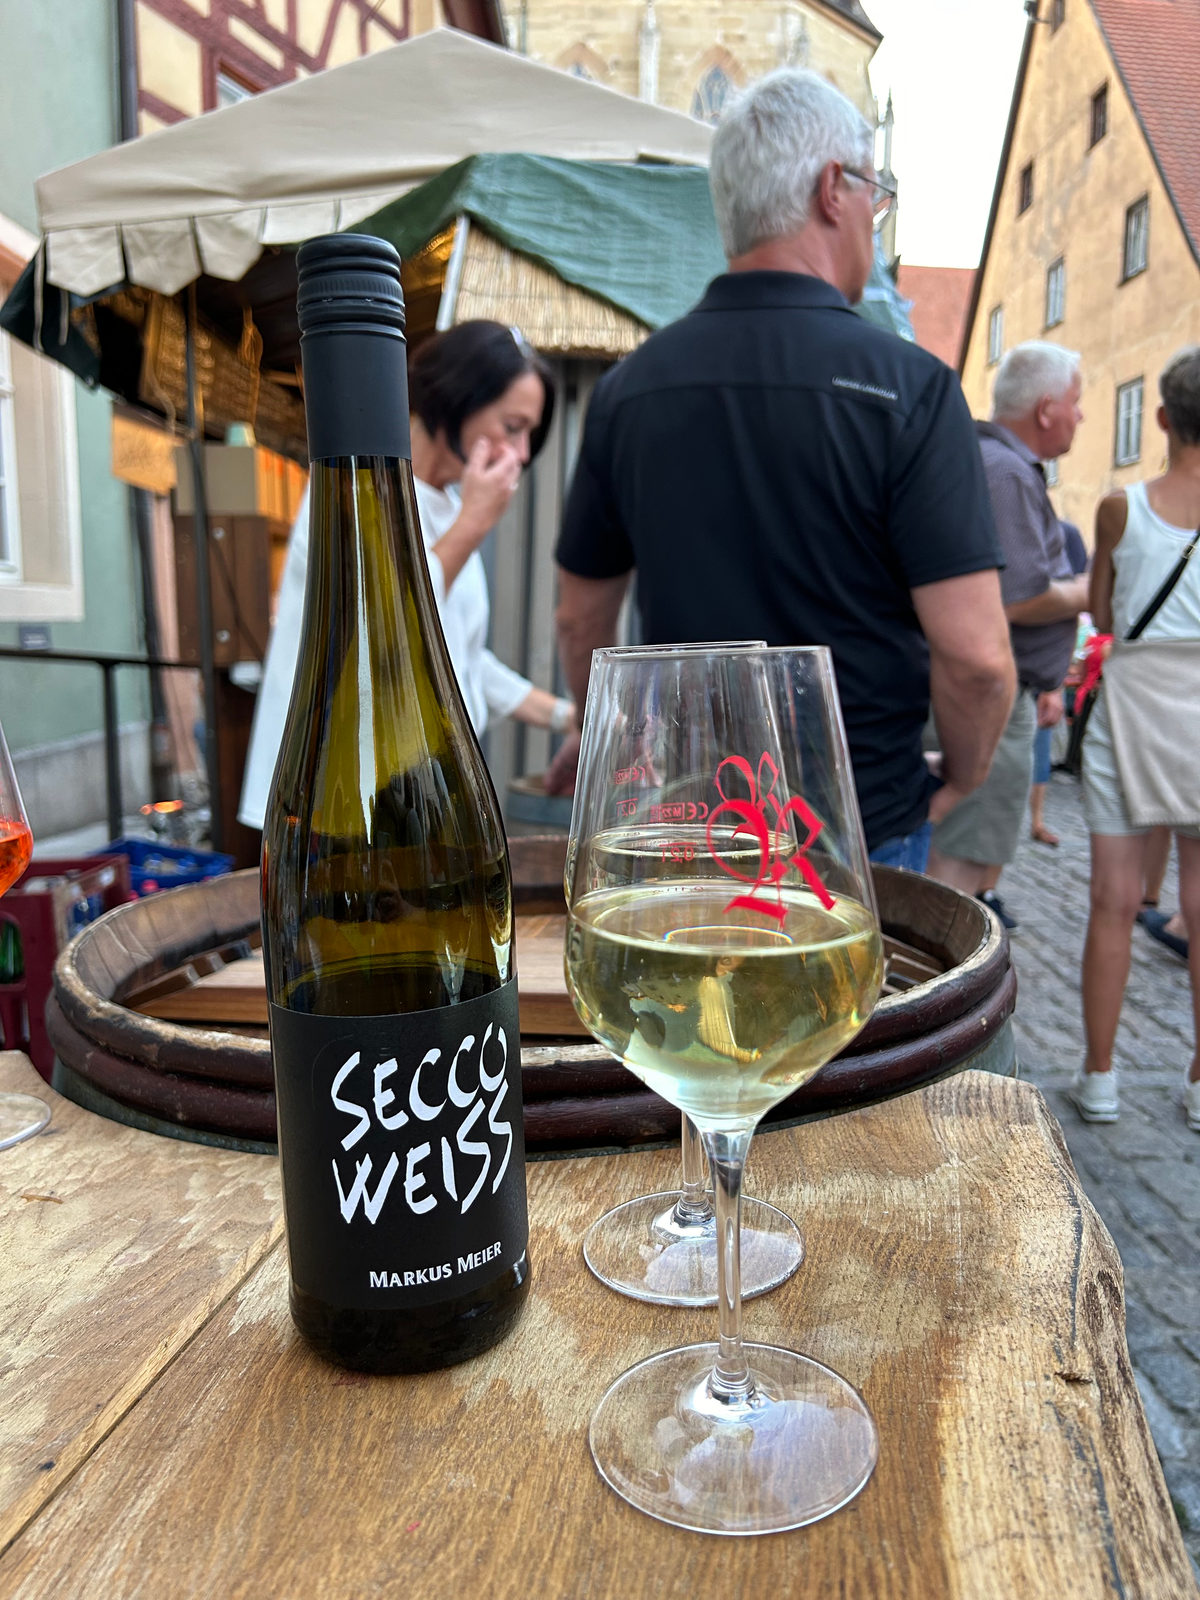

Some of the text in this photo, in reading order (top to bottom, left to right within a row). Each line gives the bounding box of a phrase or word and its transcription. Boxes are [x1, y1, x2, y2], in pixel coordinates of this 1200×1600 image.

[331, 1021, 508, 1152] SECCO
[332, 1078, 513, 1225] WEISS
[369, 1240, 503, 1289] MARKUS MEIER
